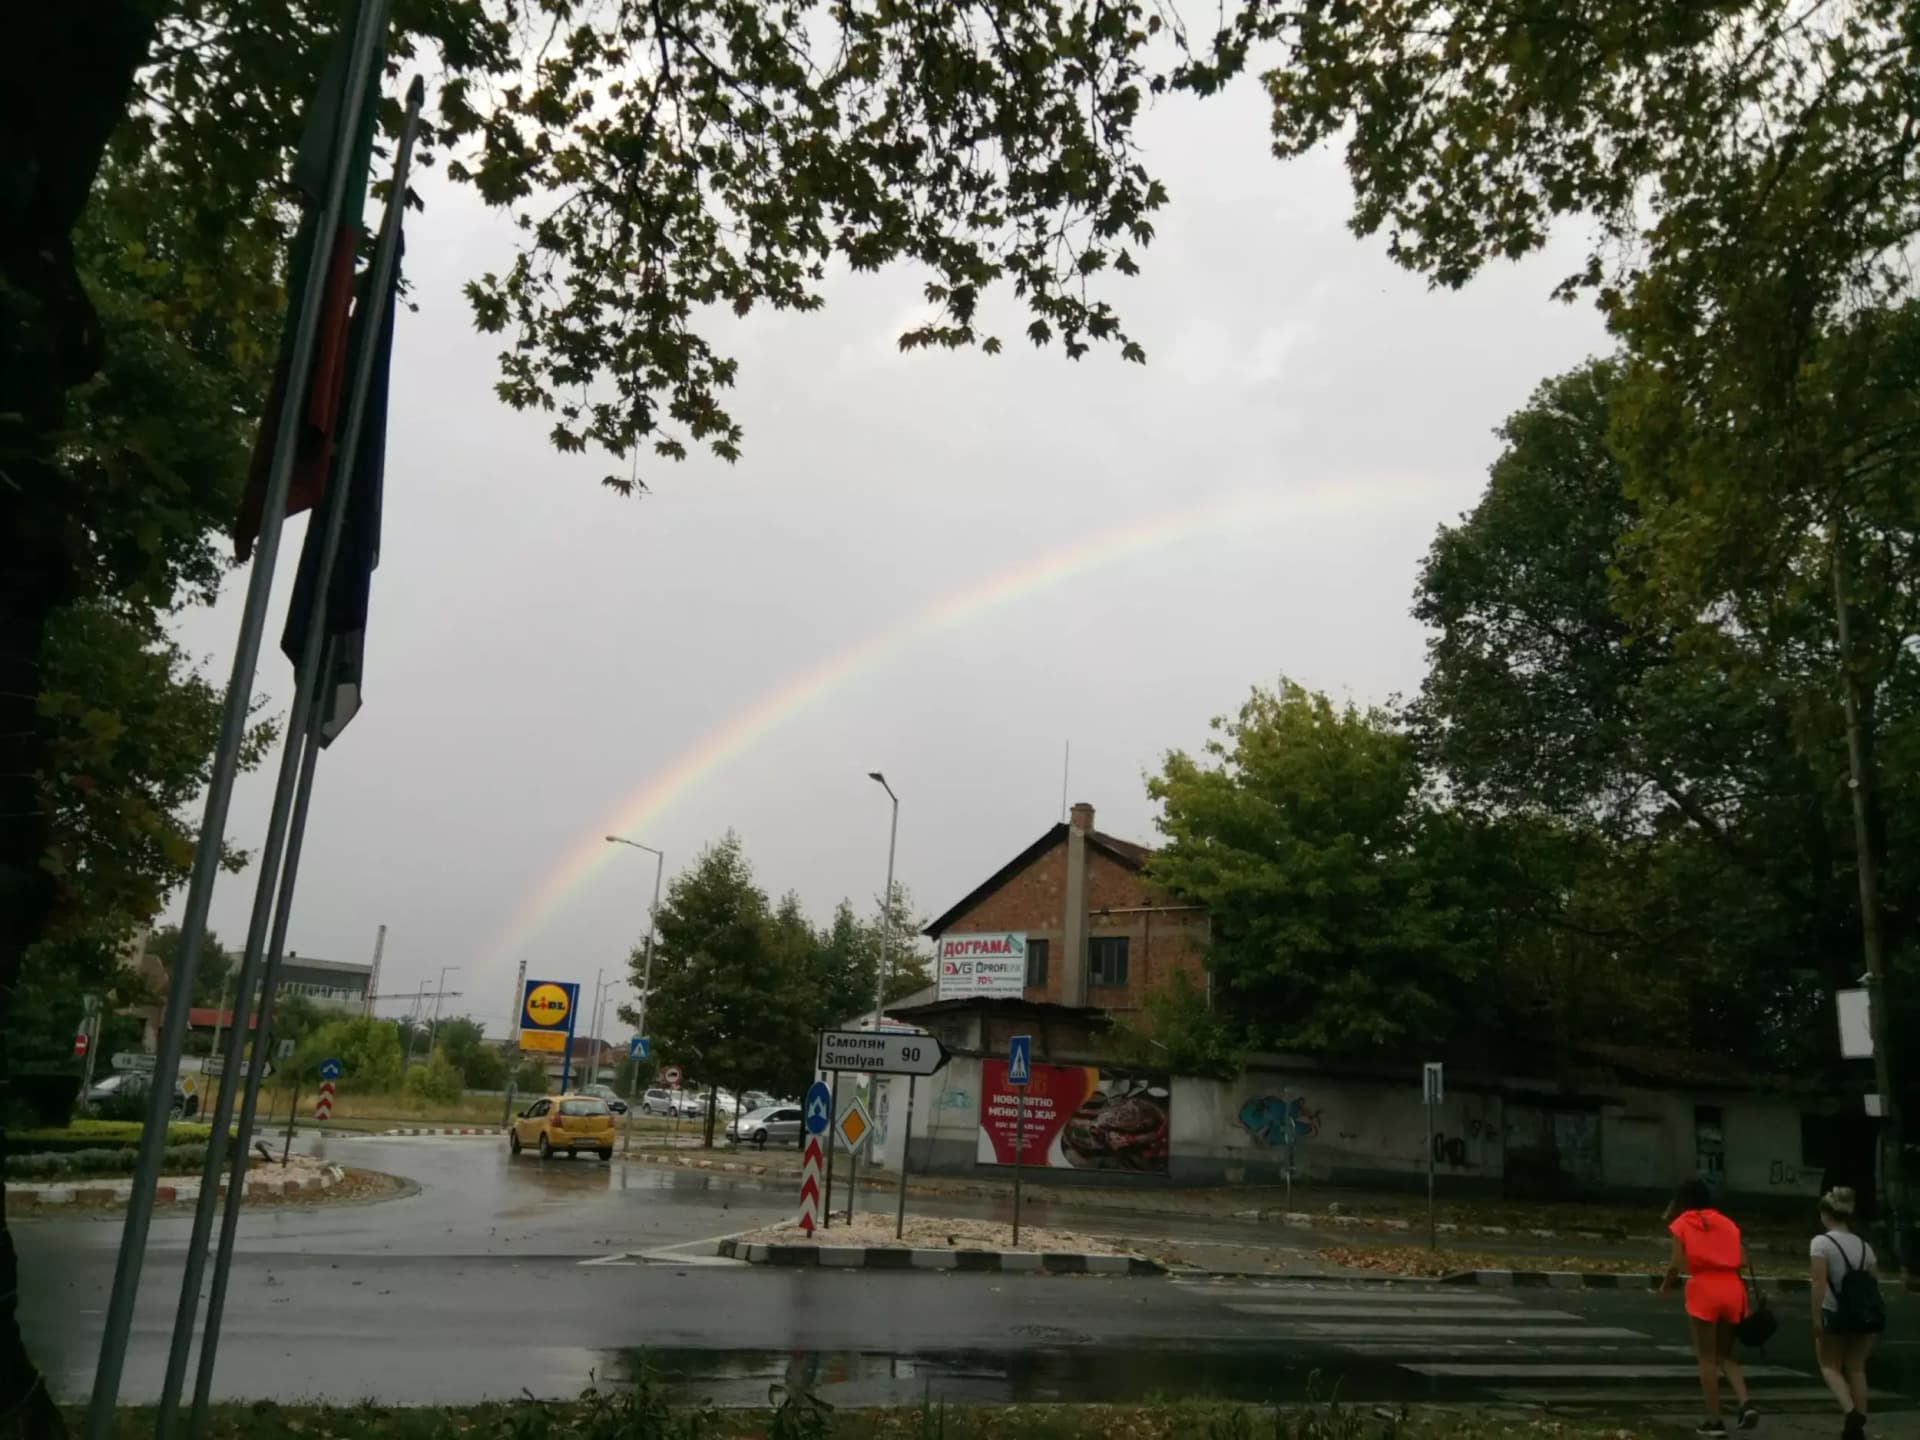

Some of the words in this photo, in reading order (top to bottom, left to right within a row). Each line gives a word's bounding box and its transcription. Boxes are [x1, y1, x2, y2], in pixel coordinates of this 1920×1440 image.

[944, 940, 1012, 957] ДОГРАМА
[530, 997, 566, 1011] LIDL
[826, 1035, 885, 1049] Смолян
[825, 1052, 884, 1067] Smolyan
[901, 1047, 921, 1062] 90
[993, 1095, 1020, 1105] НОВО
